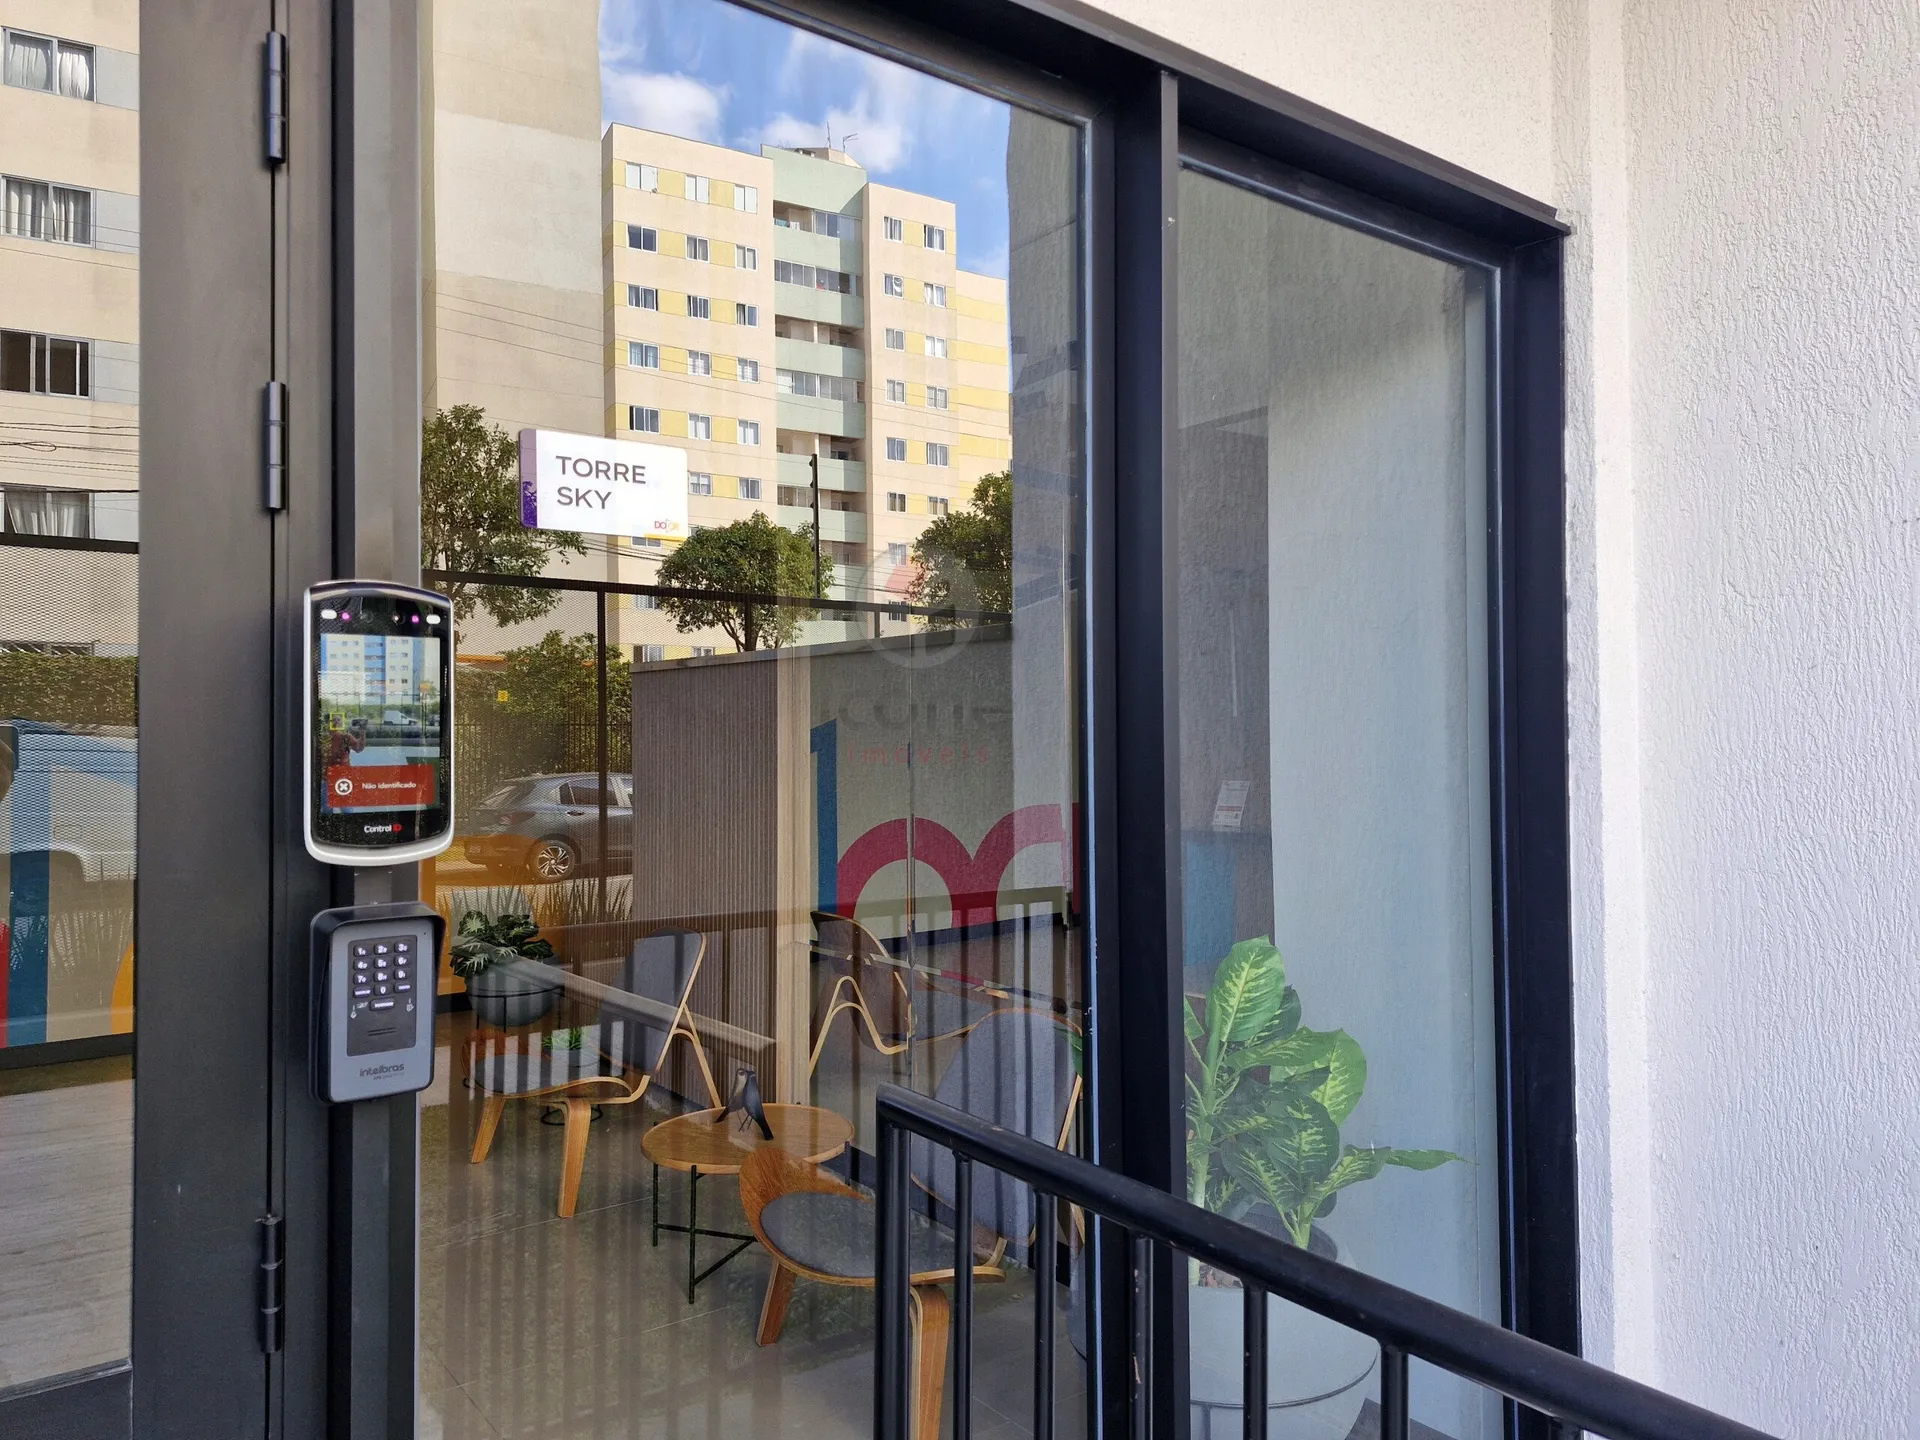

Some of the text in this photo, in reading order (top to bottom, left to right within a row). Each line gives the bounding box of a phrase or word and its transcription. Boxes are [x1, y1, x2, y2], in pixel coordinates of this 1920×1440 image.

[555, 455, 647, 485] TORRE
[557, 486, 612, 510] SKY
[364, 825, 392, 833] Control
[359, 1063, 405, 1077] intelbras
